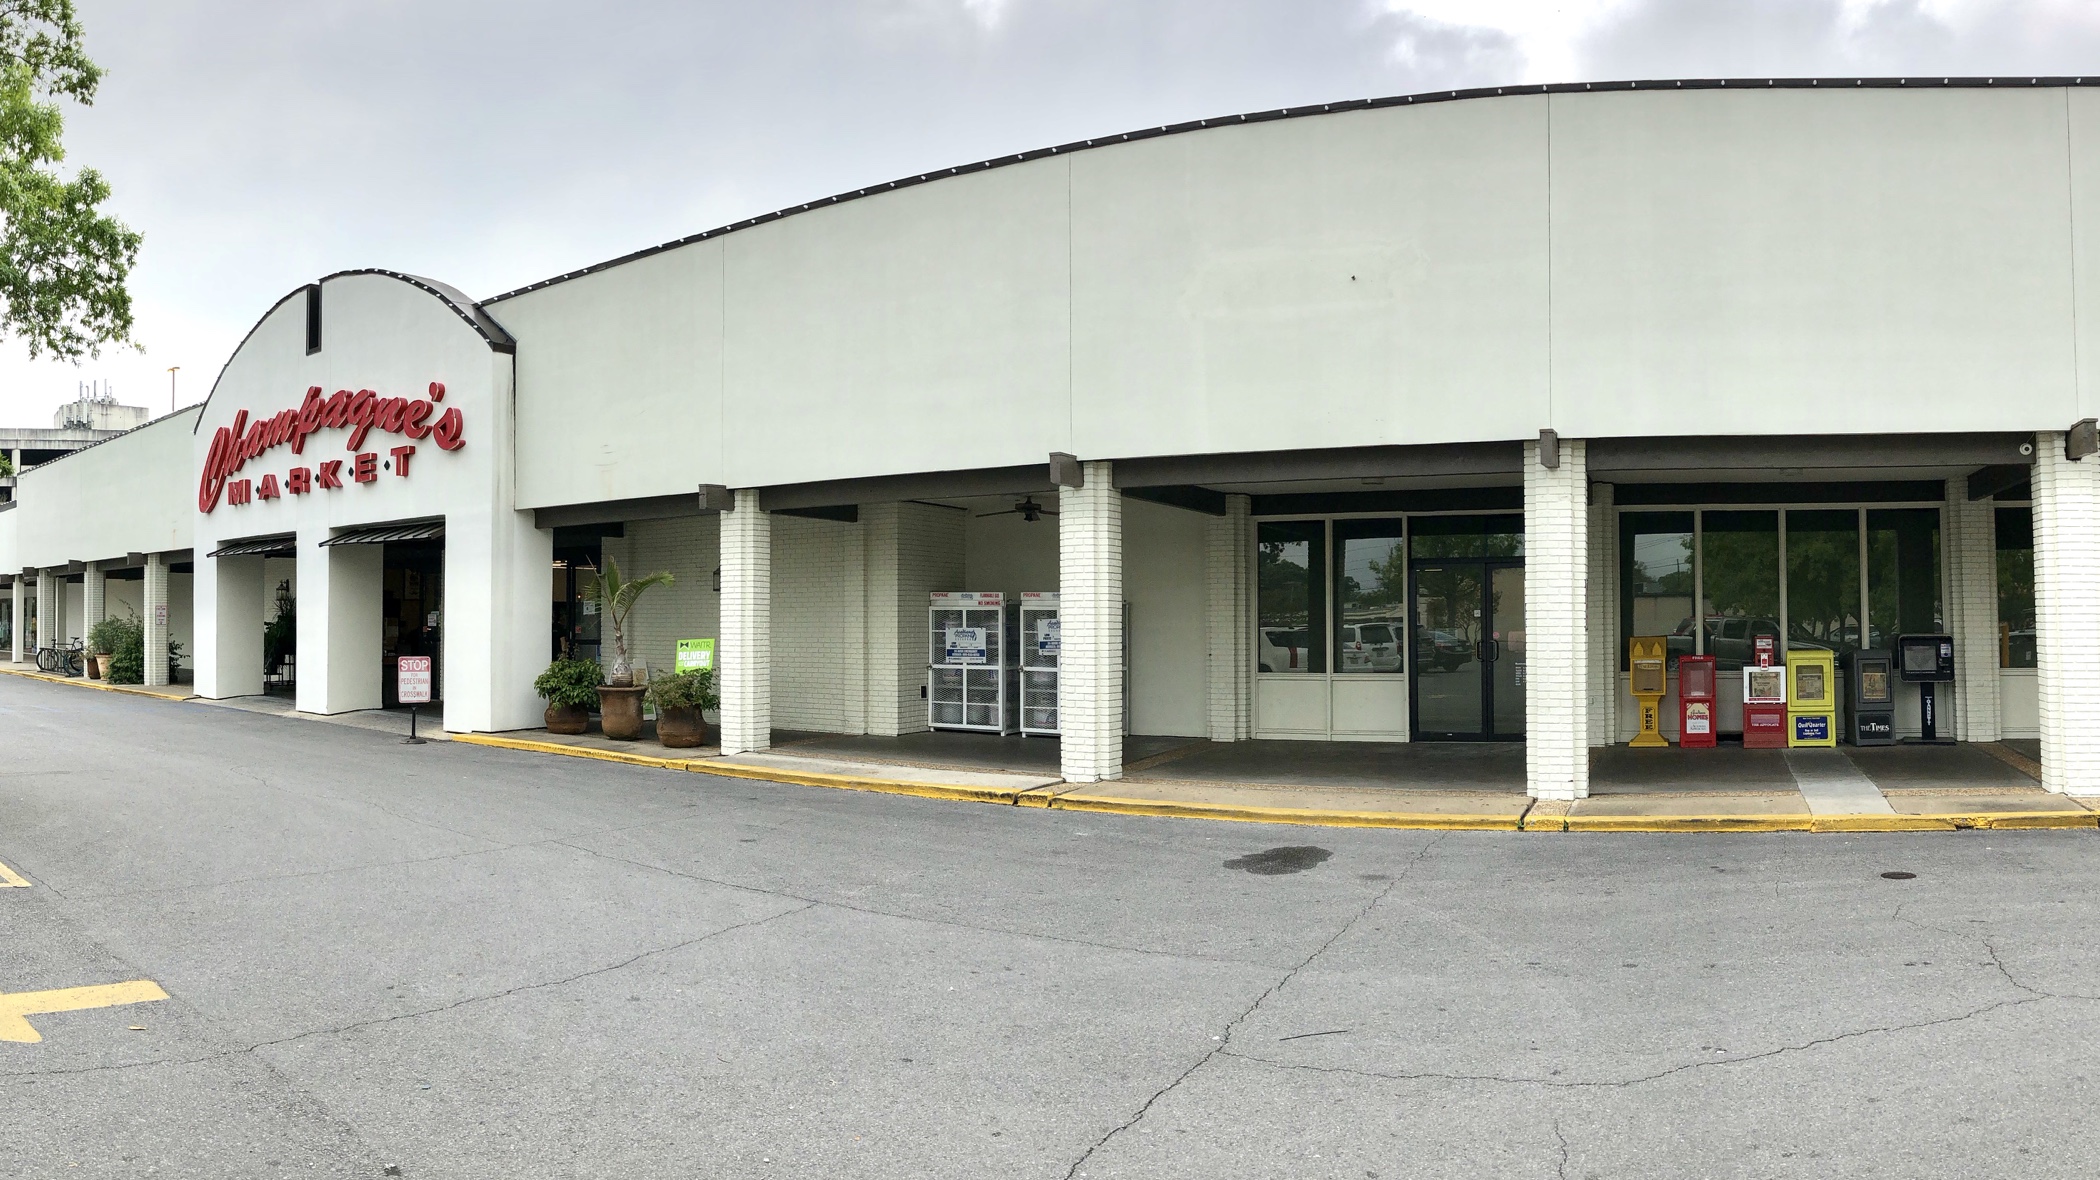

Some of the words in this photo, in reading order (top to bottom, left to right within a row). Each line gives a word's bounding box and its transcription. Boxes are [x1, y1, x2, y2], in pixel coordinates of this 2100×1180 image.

[199, 382, 466, 513] Champagne's
[679, 651, 711, 660] DELIVERY
[400, 660, 429, 671] STOP
[1645, 708, 1654, 730] FREE
[1870, 722, 1890, 732] TIMES
